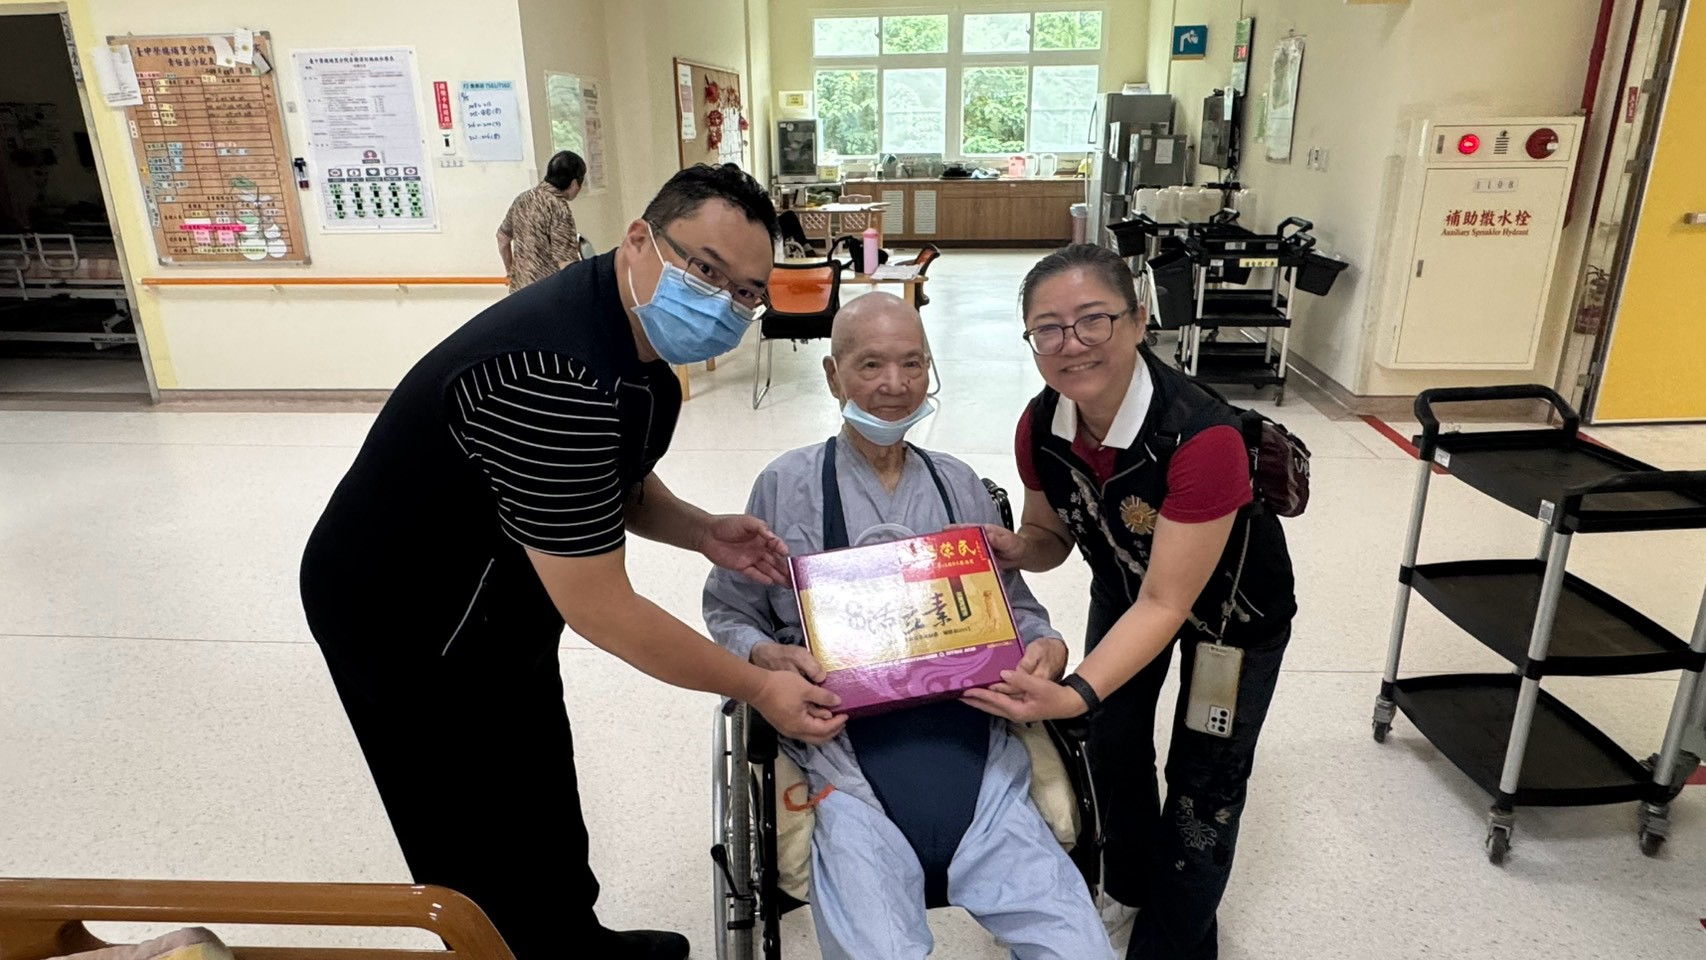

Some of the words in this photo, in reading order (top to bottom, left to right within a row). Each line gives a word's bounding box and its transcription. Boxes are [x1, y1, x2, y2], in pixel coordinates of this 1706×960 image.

[1476, 180, 1514, 189] 1108
[1441, 228, 1470, 237] Auxiliary
[1502, 228, 1529, 237] Hydrant
